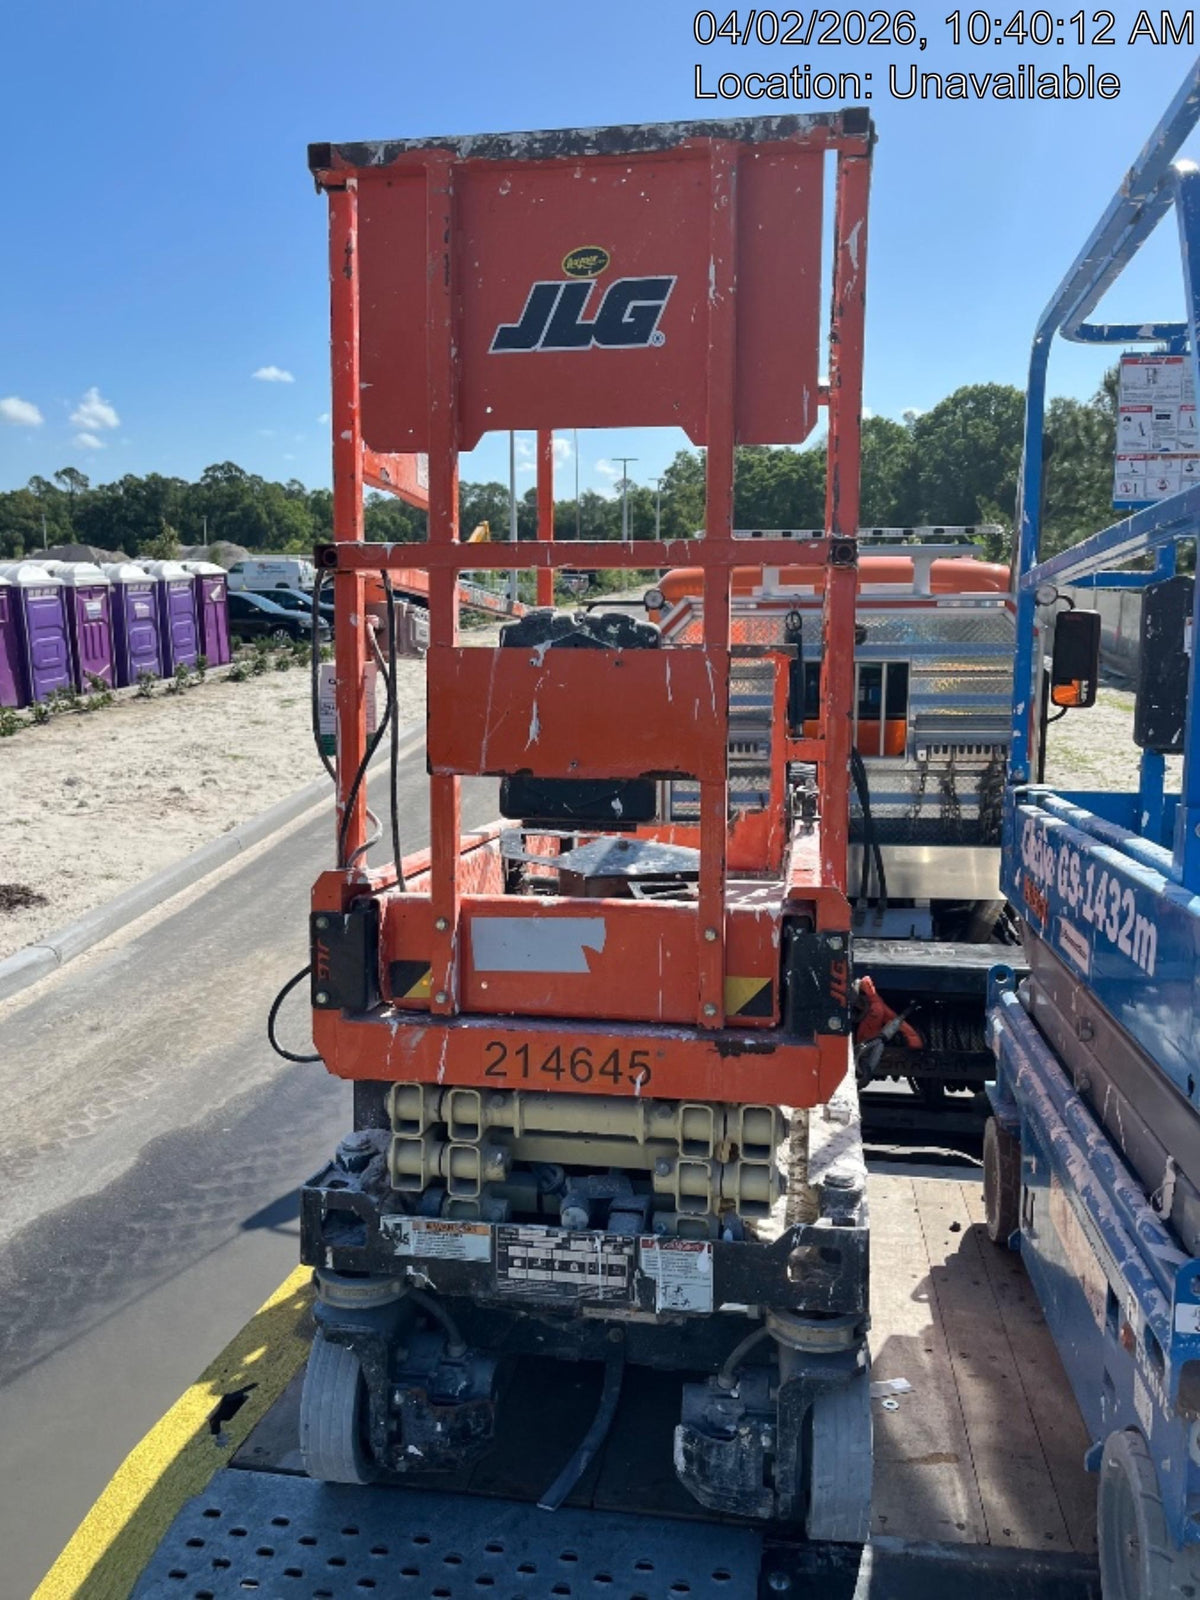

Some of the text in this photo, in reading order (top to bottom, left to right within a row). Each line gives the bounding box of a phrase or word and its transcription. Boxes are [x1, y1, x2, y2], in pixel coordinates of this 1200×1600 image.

[1057, 845, 1157, 977] GS-1432m
[830, 959, 847, 1008] JLG
[484, 1041, 652, 1087] 214645
